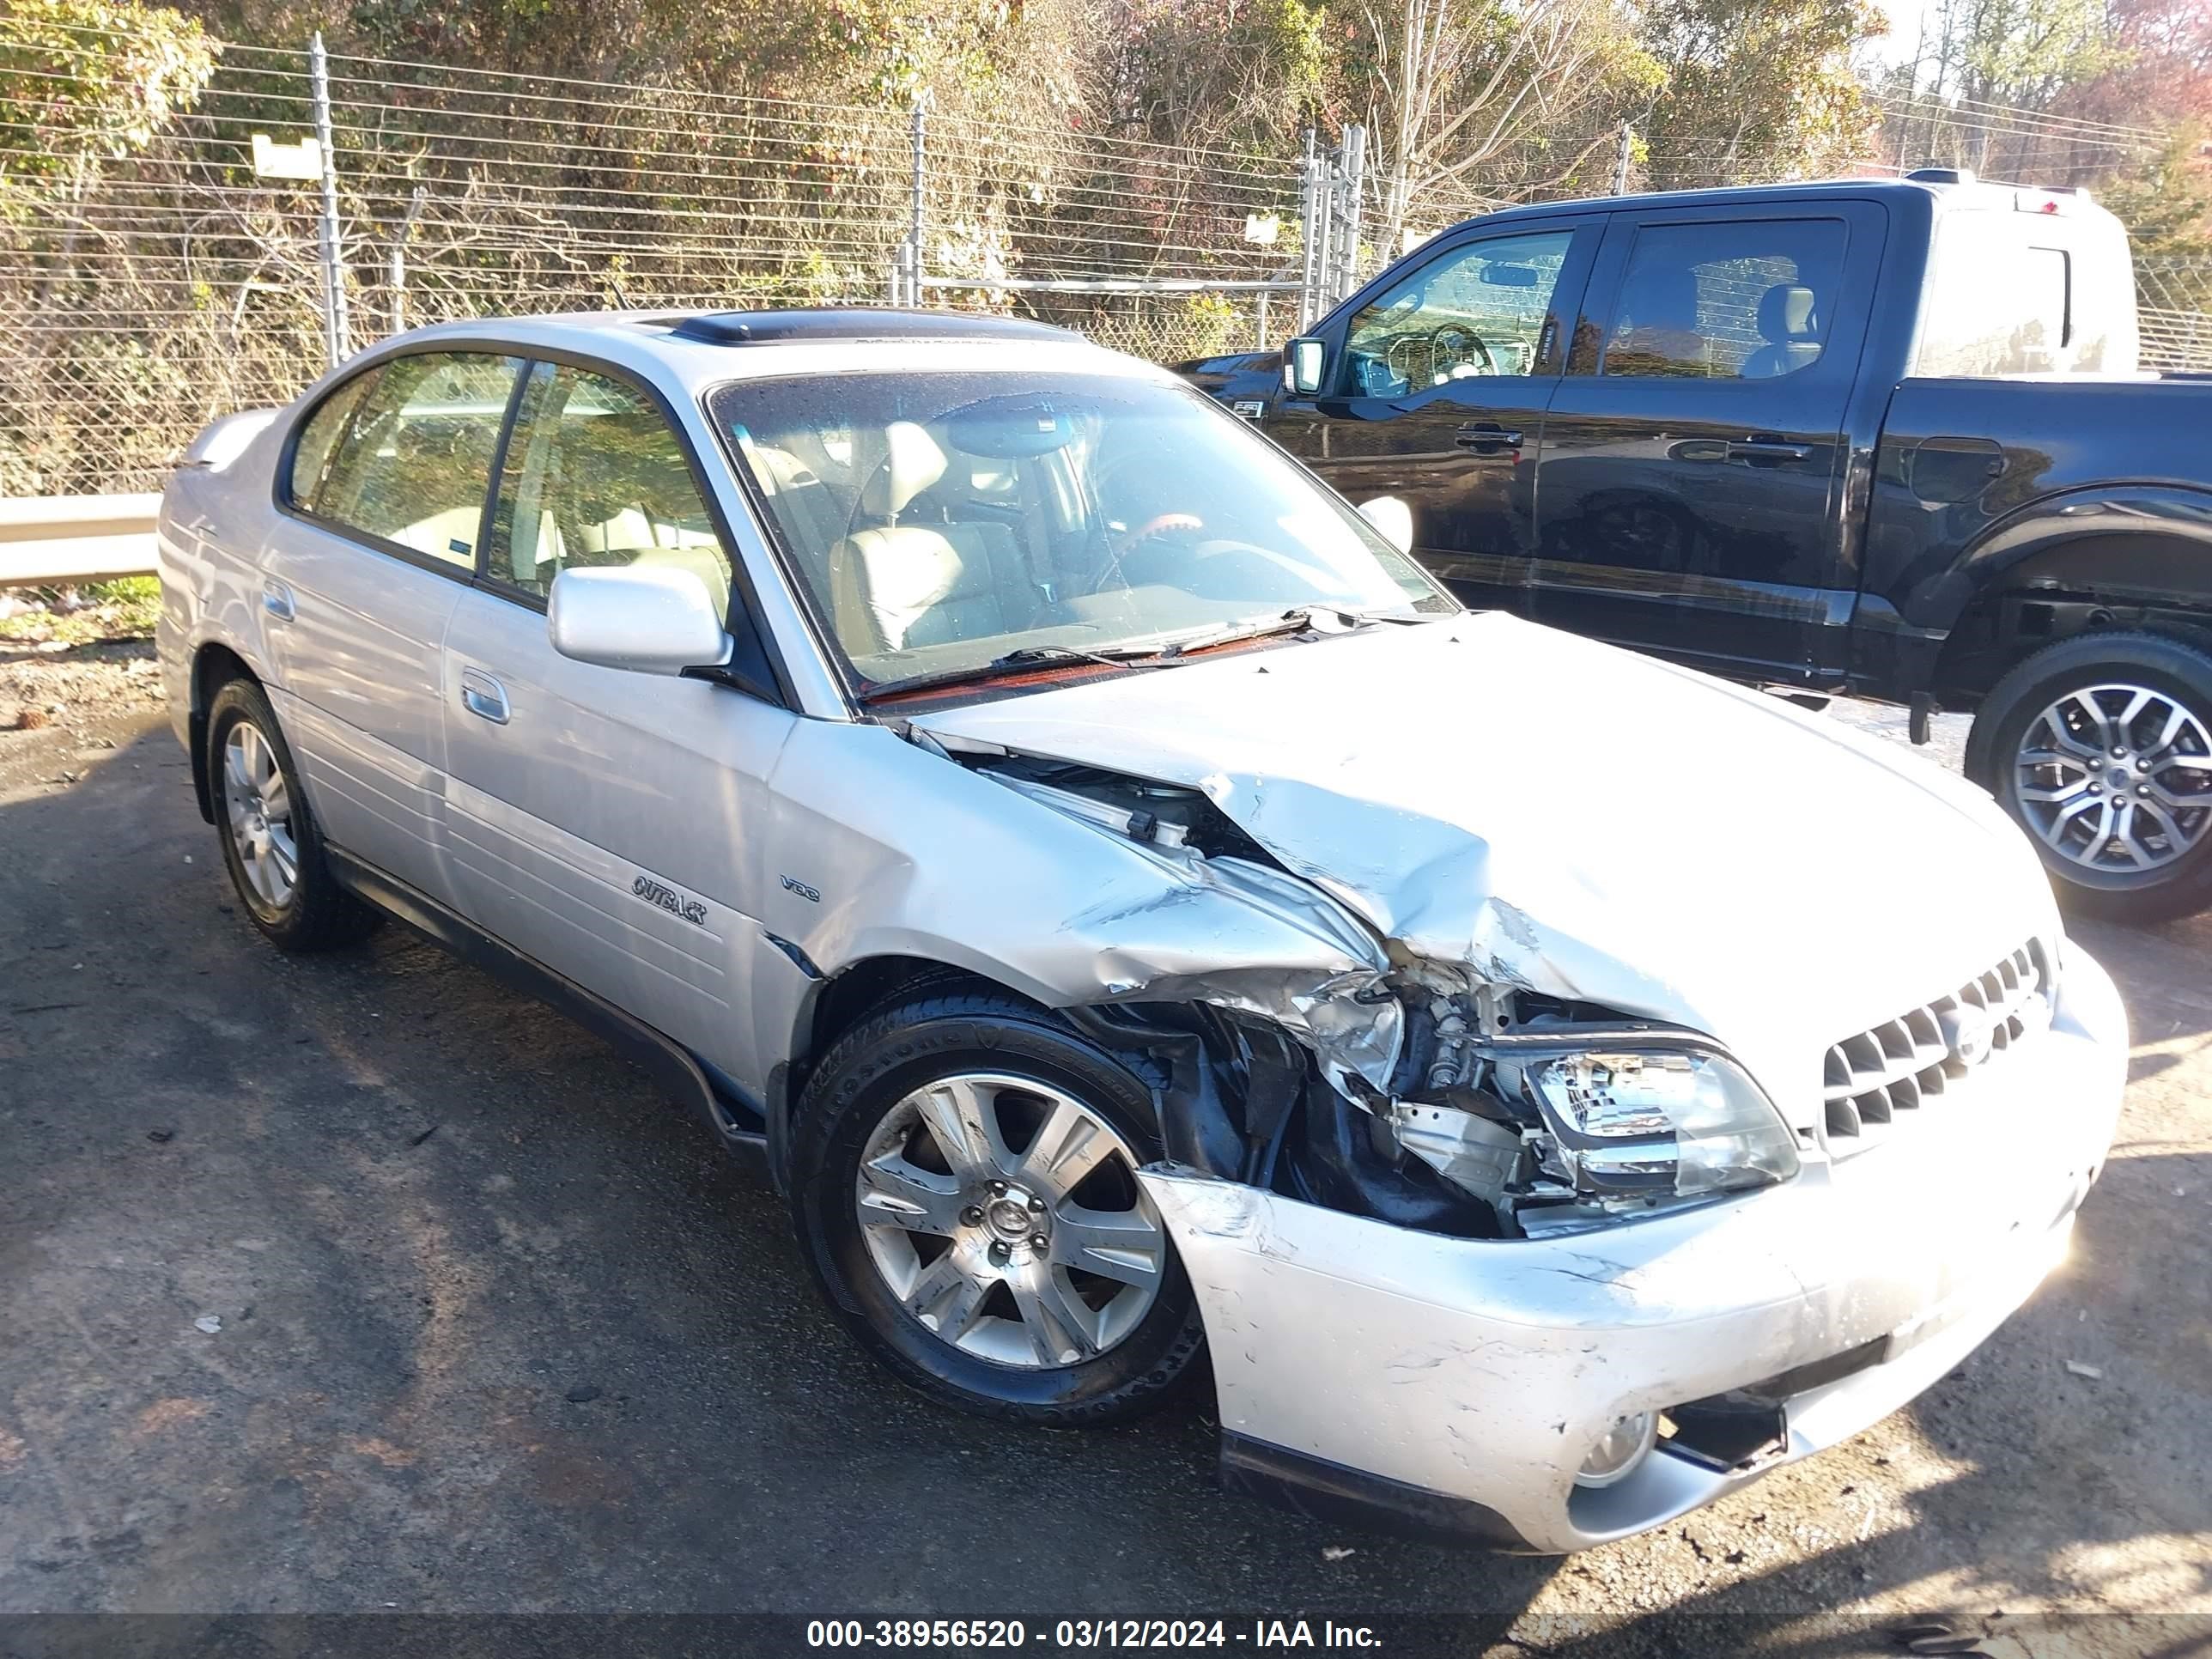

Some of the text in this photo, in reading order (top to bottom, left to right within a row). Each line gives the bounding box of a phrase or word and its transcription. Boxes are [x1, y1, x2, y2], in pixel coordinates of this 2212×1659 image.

[632, 876, 707, 924] OUTBACK
[780, 874, 820, 902] VDC
[1060, 1053, 1140, 1108] SEASON
